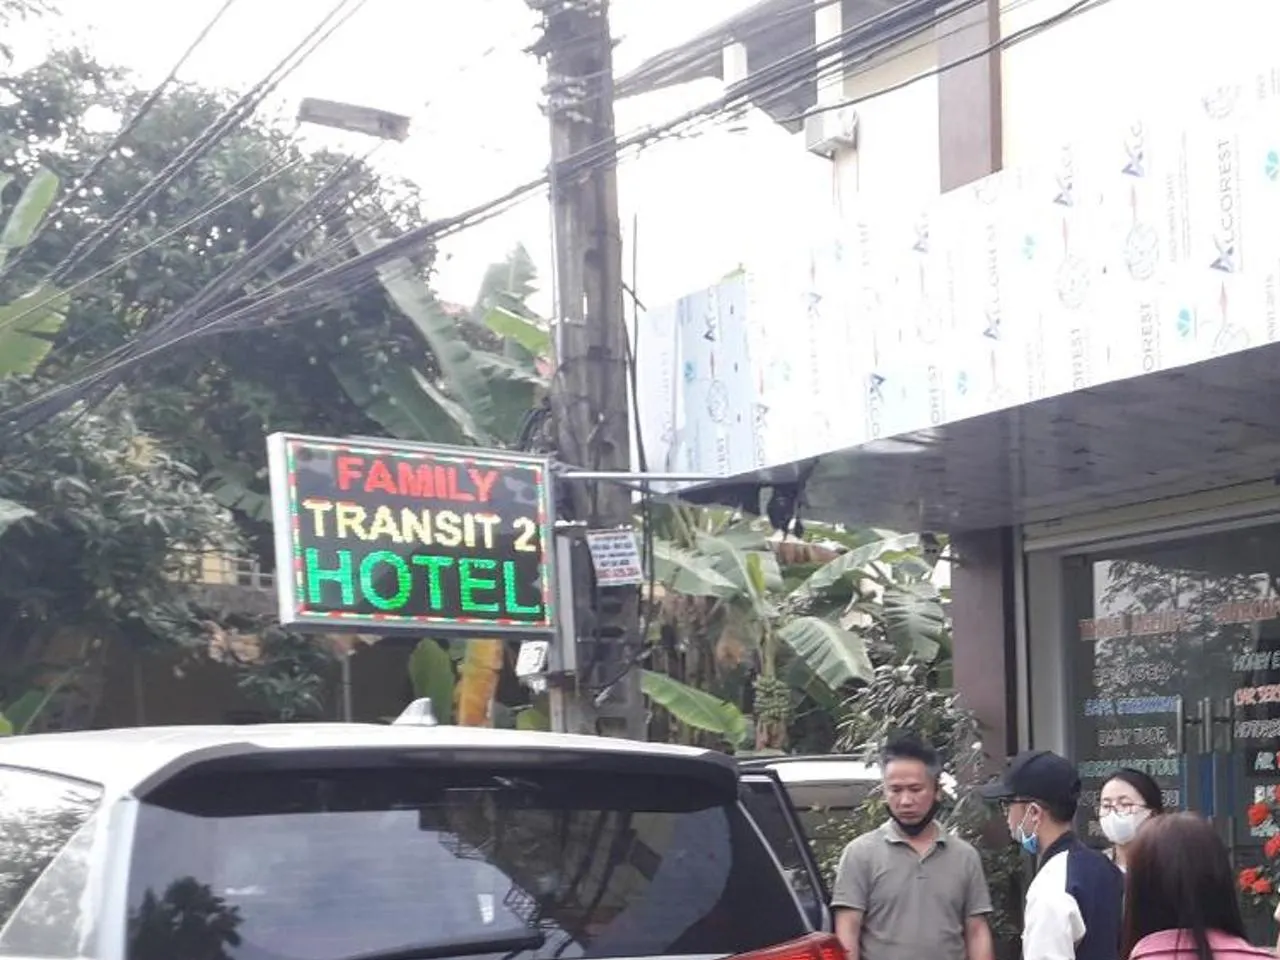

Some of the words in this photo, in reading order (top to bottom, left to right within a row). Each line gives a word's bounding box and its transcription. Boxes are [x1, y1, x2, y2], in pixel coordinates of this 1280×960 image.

[337, 456, 499, 502] FAMILY
[302, 496, 501, 548] TRANSIT
[513, 516, 537, 552] 2
[304, 547, 541, 614] HOTEL
